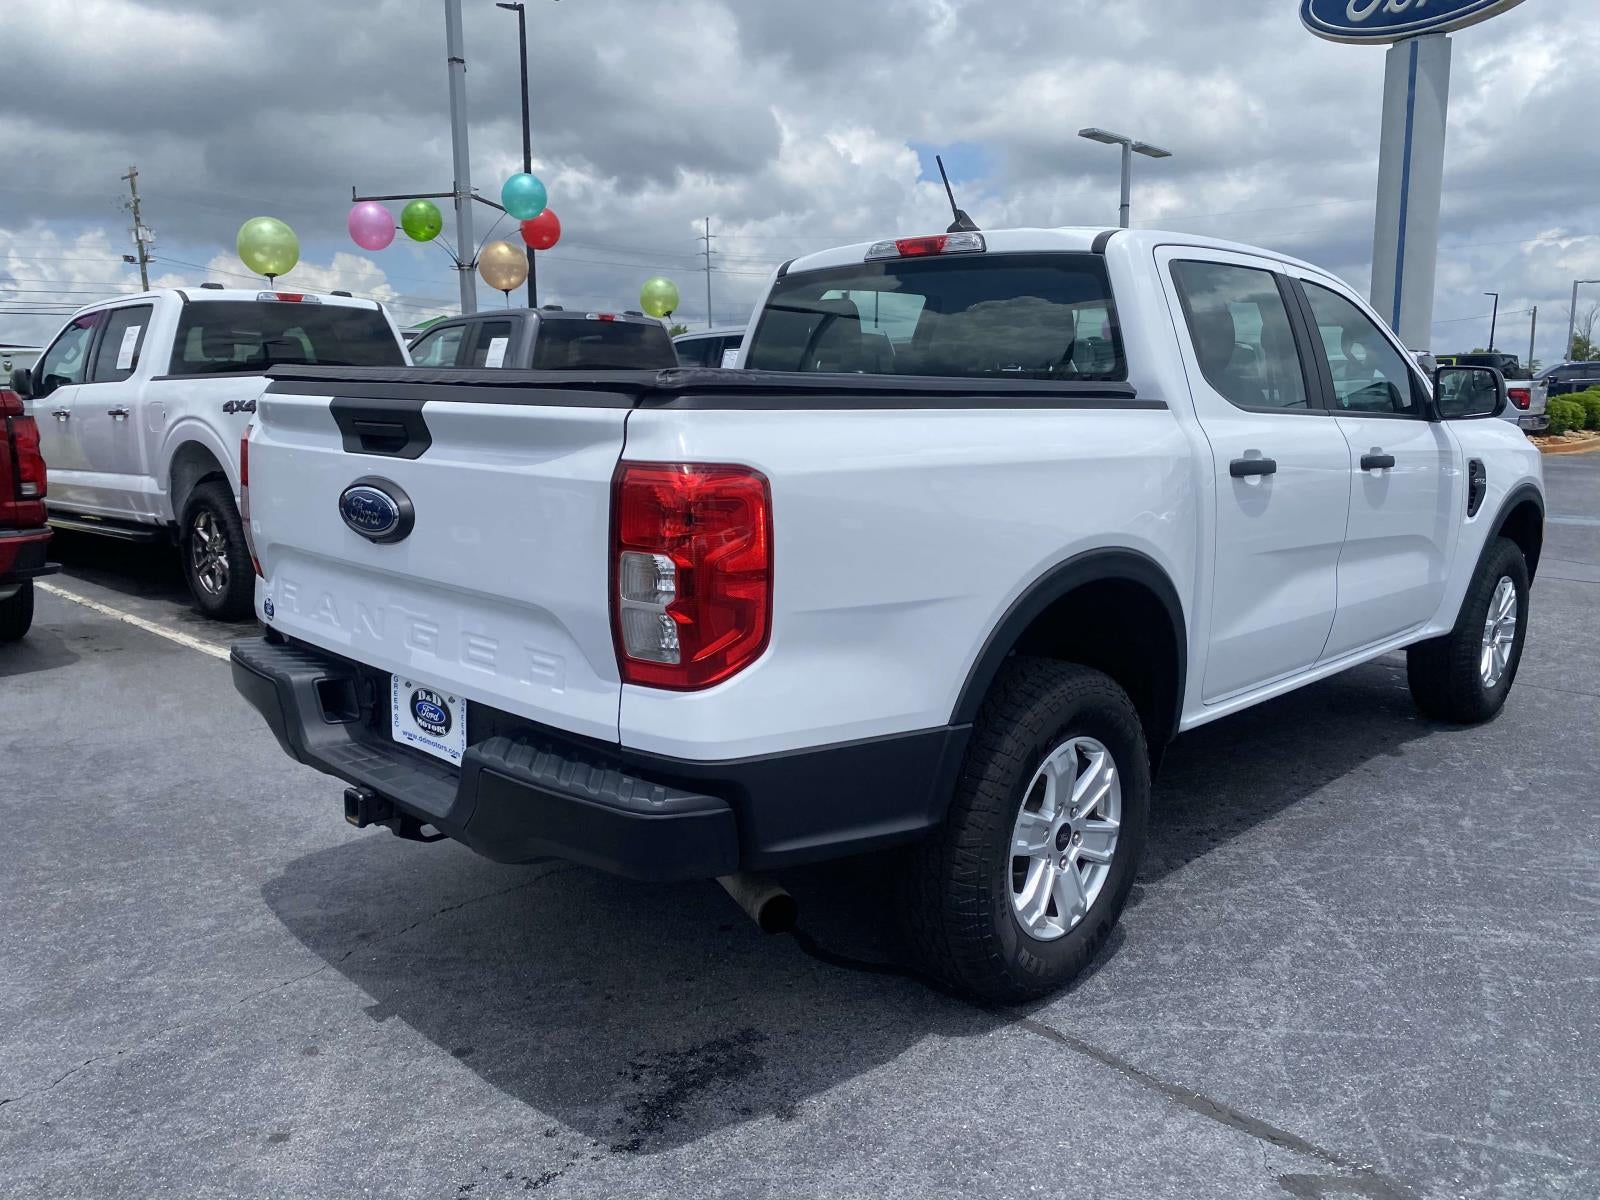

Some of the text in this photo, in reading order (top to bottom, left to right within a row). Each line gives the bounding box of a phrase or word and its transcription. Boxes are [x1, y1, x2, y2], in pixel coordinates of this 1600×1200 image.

[350, 495, 381, 525] Ford
[278, 579, 566, 693] RANGER
[417, 690, 442, 707] D&D
[394, 713, 400, 728] SC
[421, 704, 440, 722] Ford
[417, 716, 446, 733] MOTORS
